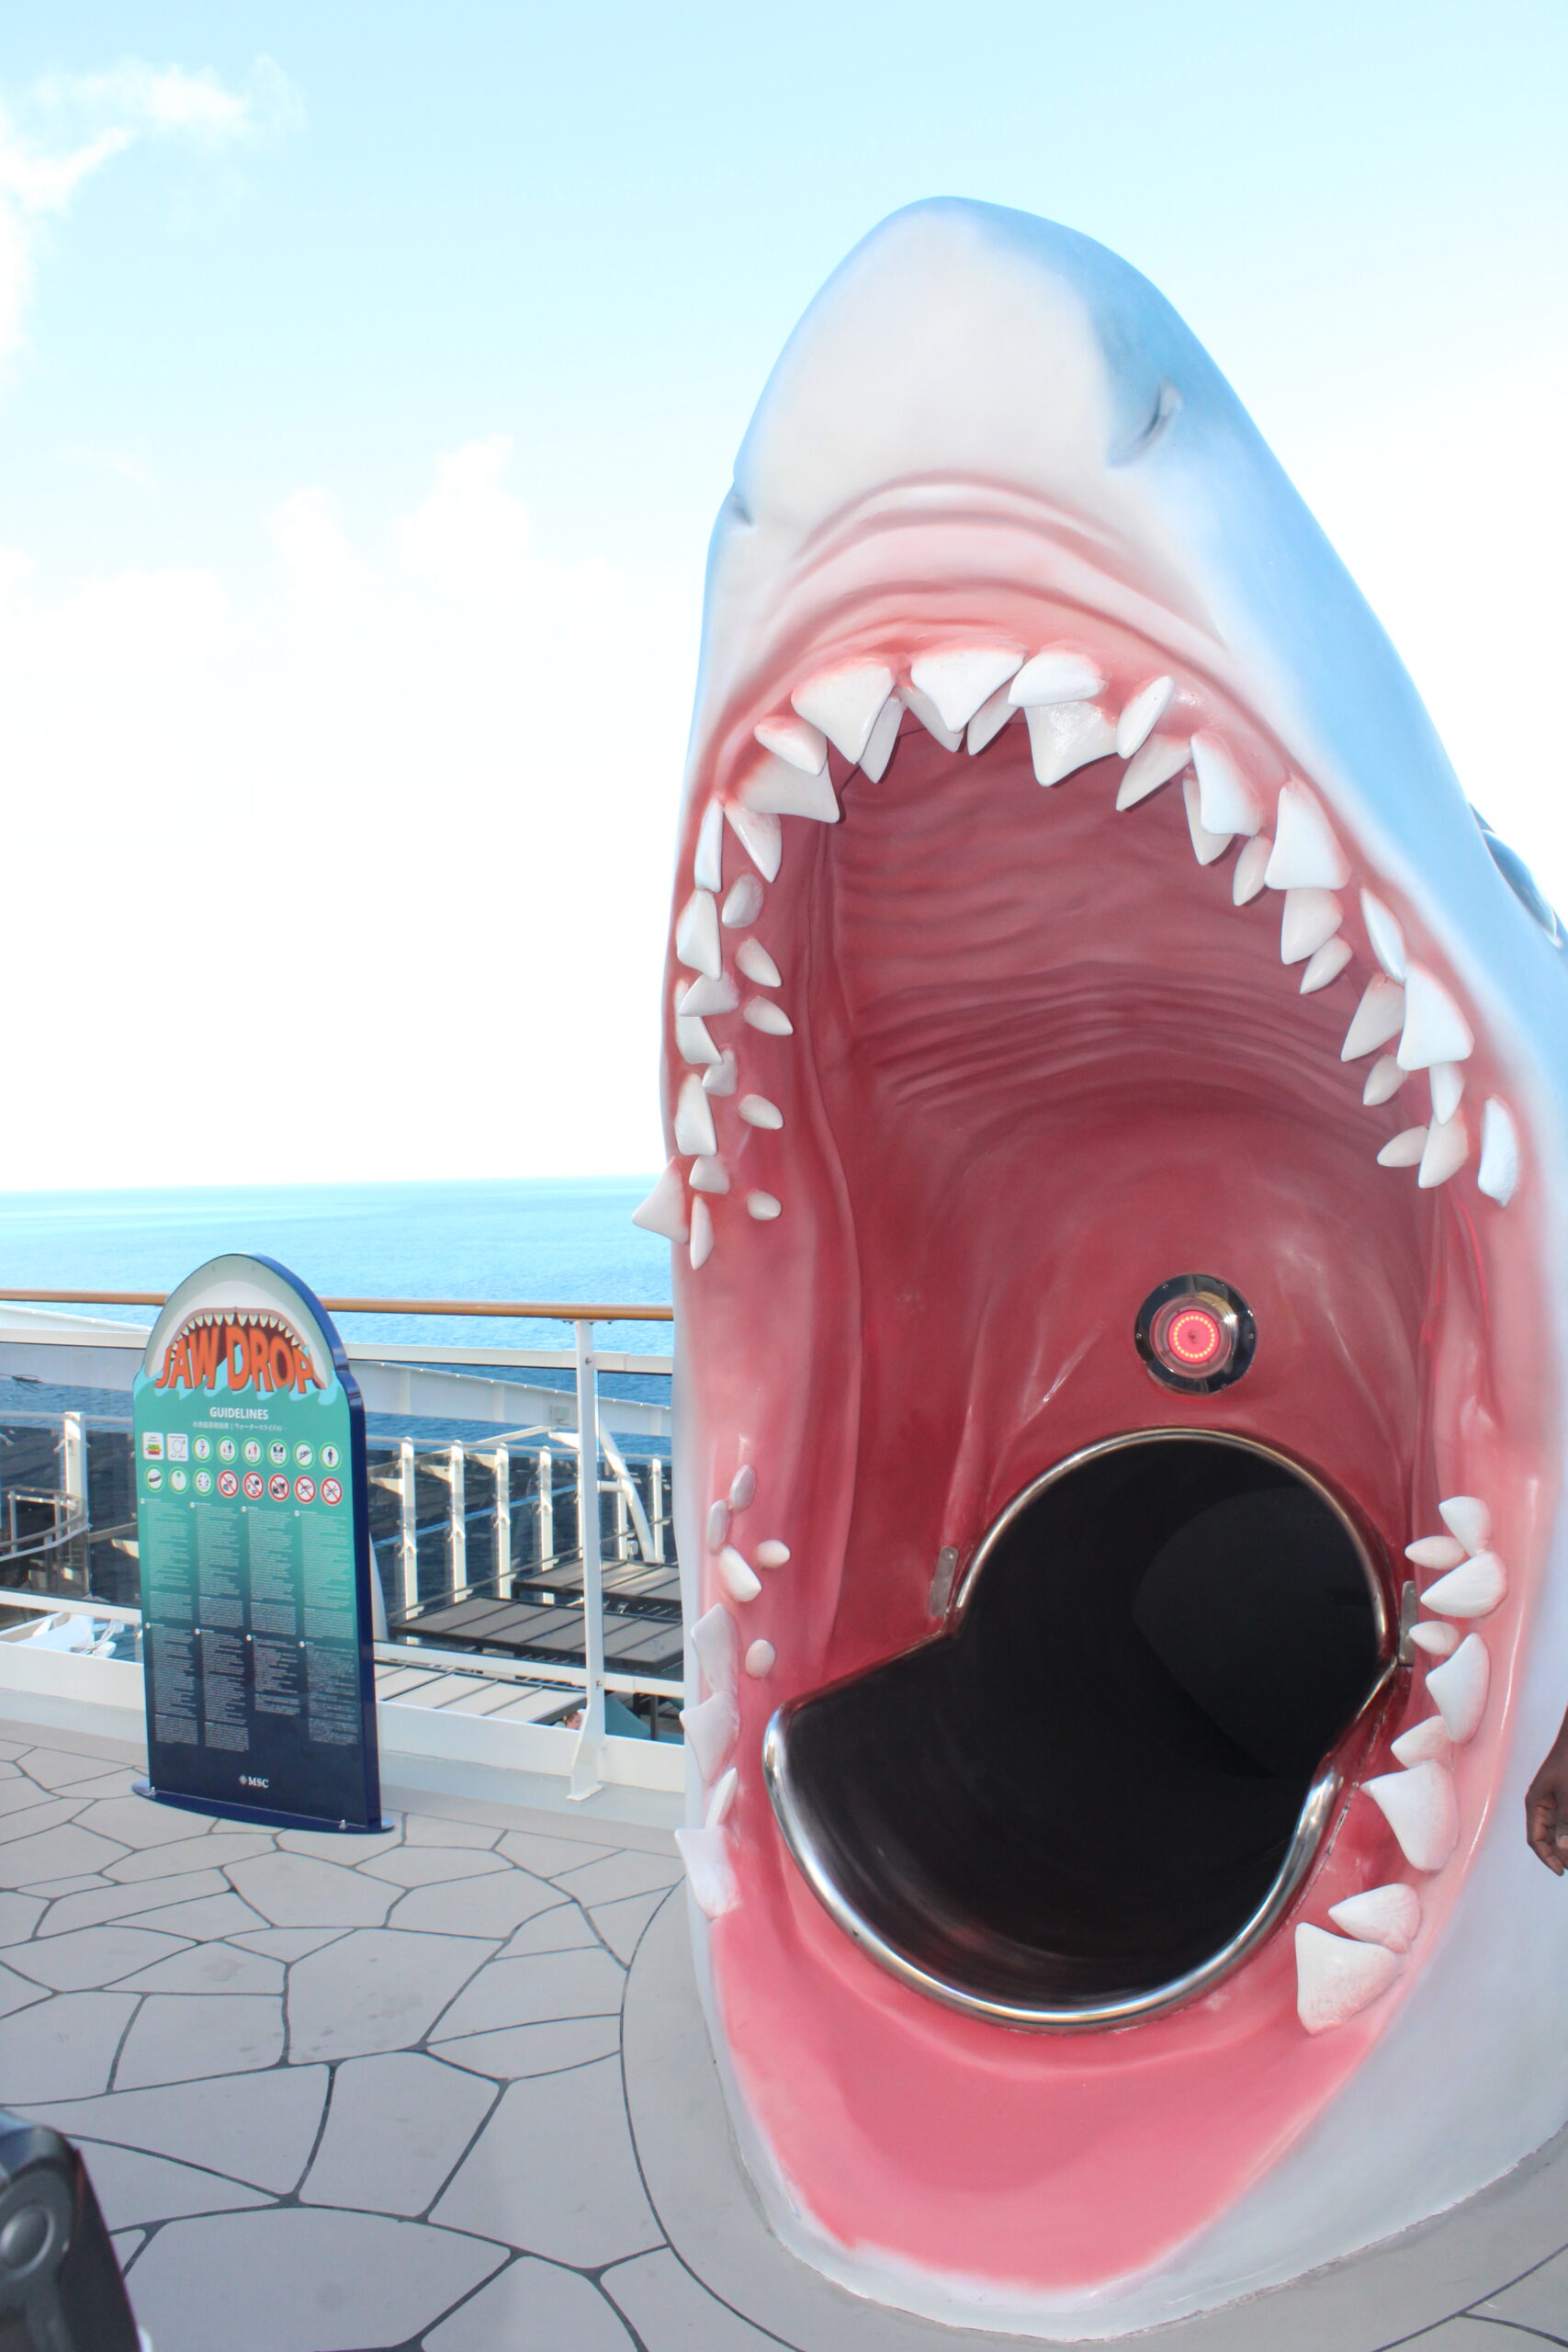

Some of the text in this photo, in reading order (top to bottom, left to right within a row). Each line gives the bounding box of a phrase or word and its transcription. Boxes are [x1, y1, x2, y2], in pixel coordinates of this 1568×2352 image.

[154, 1325, 314, 1394] JAW DROP
[209, 1407, 268, 1420] GUIDELINES
[248, 1776, 269, 1788] MSC
